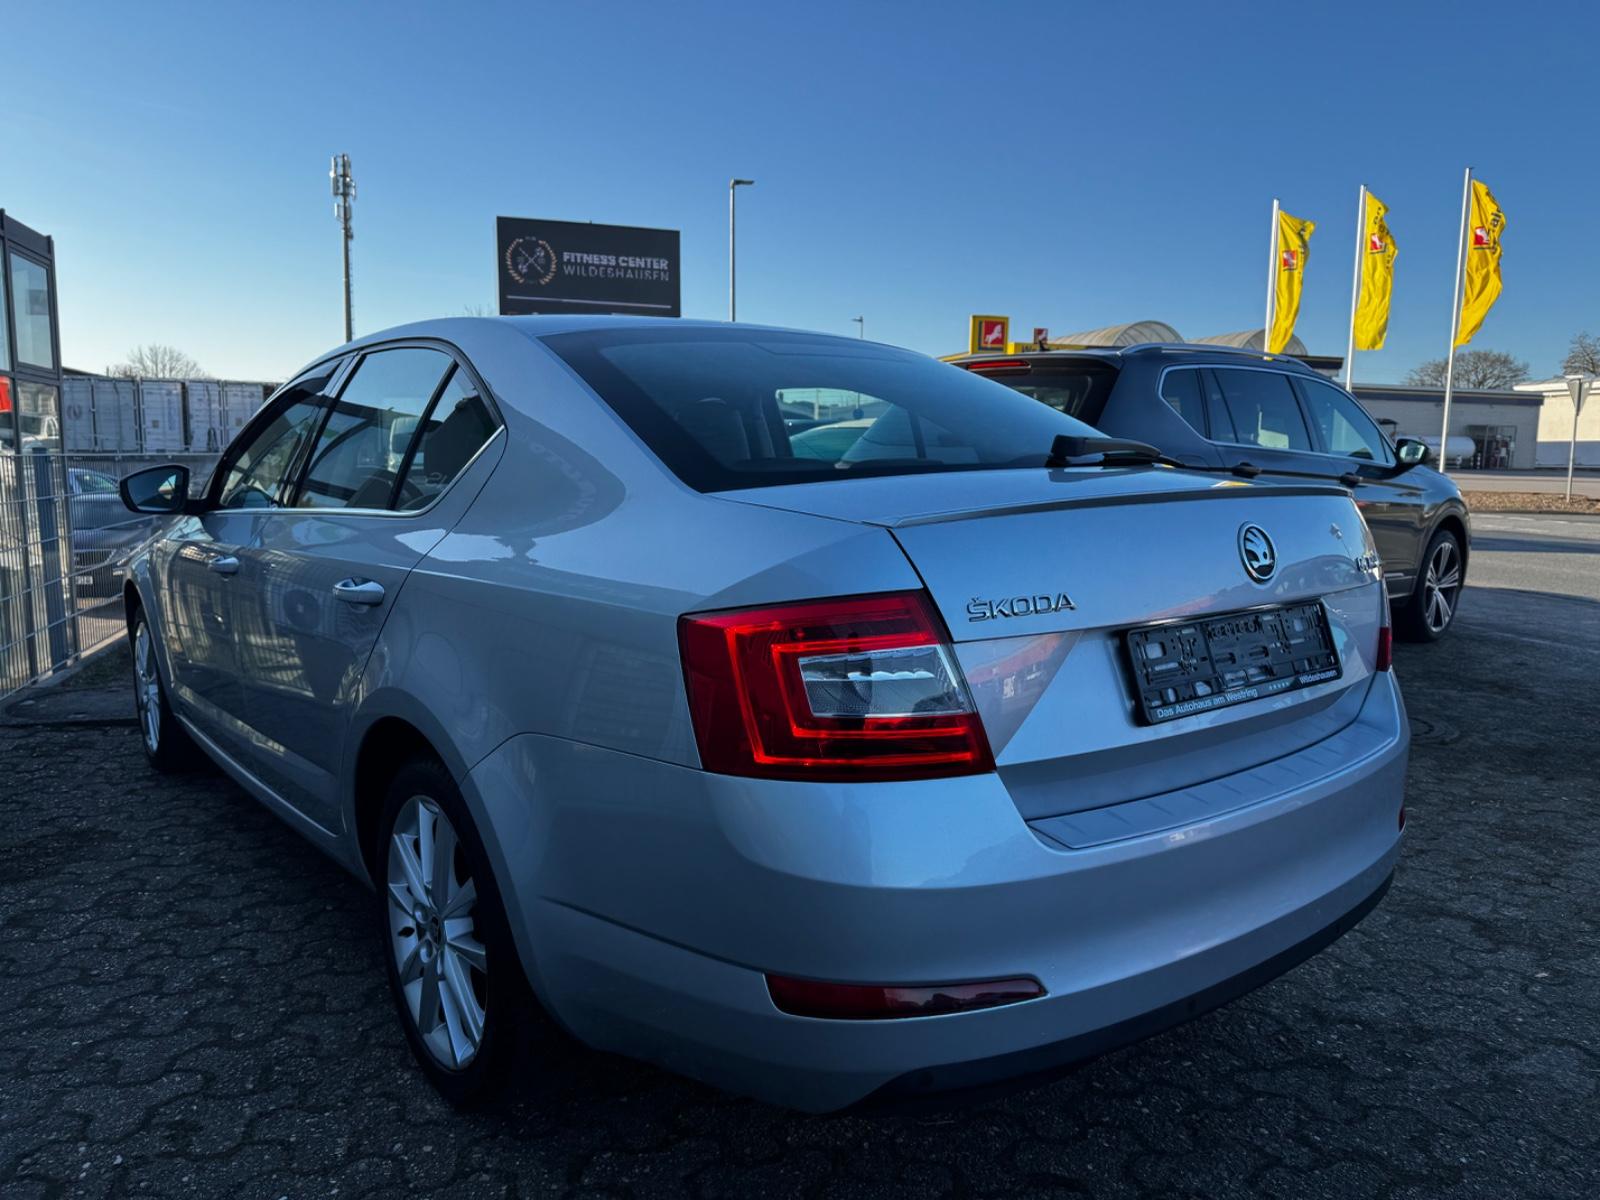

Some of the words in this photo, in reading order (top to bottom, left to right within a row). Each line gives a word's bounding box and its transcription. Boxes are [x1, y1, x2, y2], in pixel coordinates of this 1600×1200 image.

[563, 252, 616, 266] FITNESS
[618, 255, 669, 270] CENTER
[563, 264, 670, 281] WILDESHAUSEN
[966, 592, 1077, 623] ŠKODA
[1156, 708, 1174, 718] Das
[1175, 699, 1213, 714] Autohaus
[1213, 696, 1226, 705] am
[1225, 688, 1258, 702] Westring
